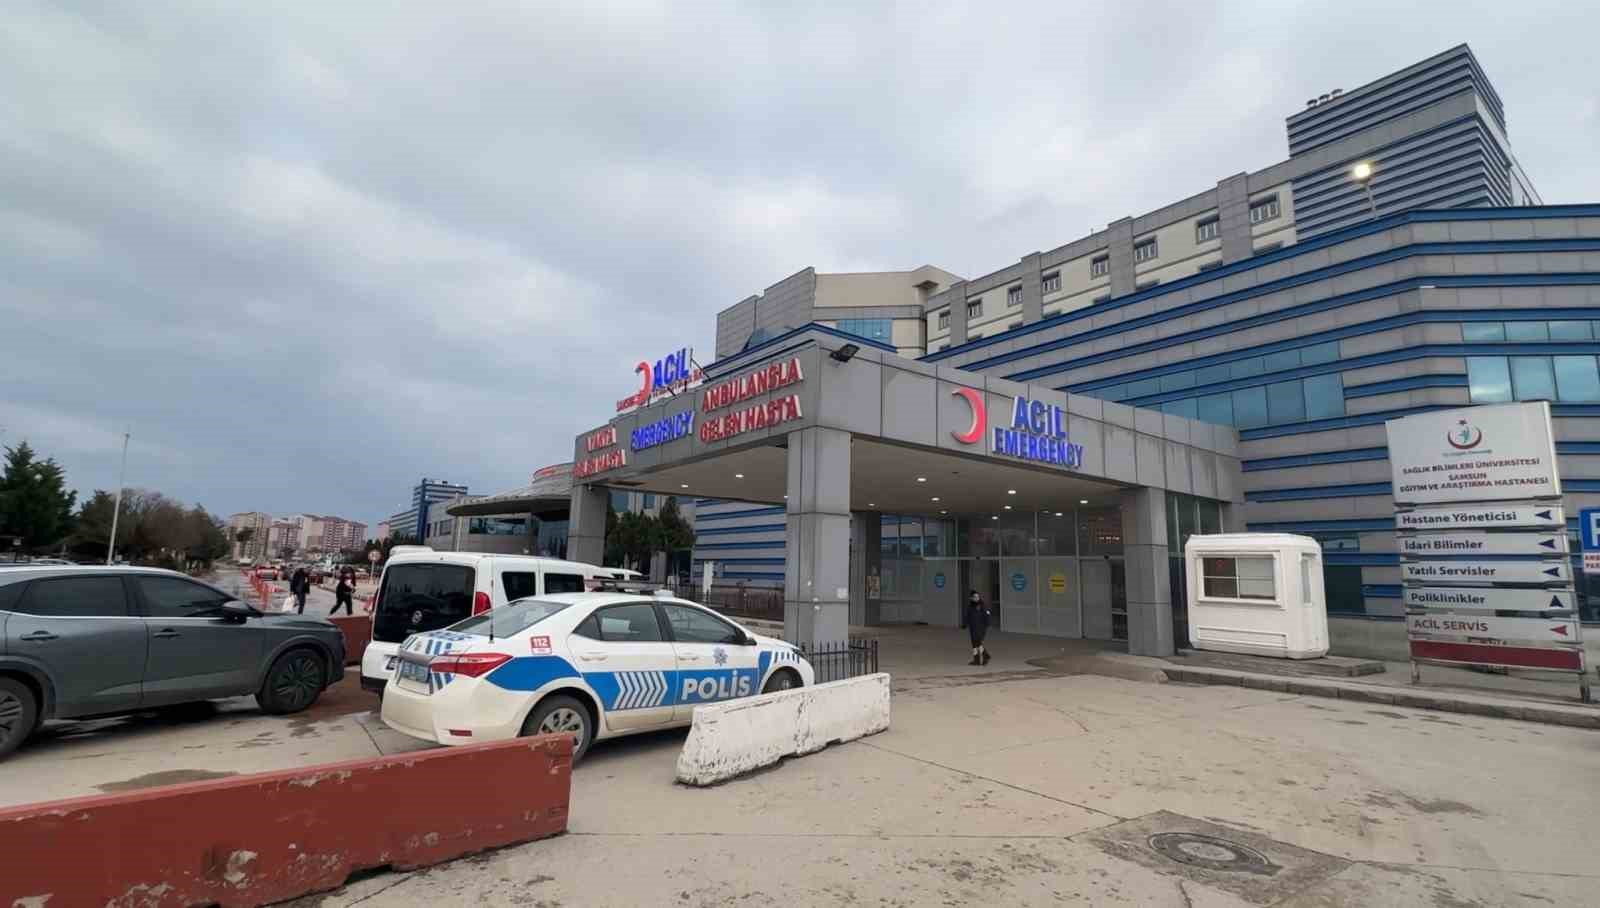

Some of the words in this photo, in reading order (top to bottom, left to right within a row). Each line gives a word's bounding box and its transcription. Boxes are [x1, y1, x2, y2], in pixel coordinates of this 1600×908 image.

[699, 411, 746, 442] GELEN
[746, 394, 803, 430] HASTA
[991, 426, 1086, 469] EMERGENCY
[1448, 472, 1488, 481] SAMSUN
[1428, 482, 1440, 491] VE
[1402, 512, 1450, 526] Hastane
[1452, 510, 1518, 525] Yöneticisi
[1433, 540, 1484, 551] Bilimler
[1439, 565, 1497, 577] Servisler
[1410, 592, 1486, 605] Poliklinikler
[1413, 618, 1441, 630] ACİL
[1443, 619, 1489, 633] SERVİS
[532, 638, 550, 648] 112
[681, 670, 751, 701] POLİS
